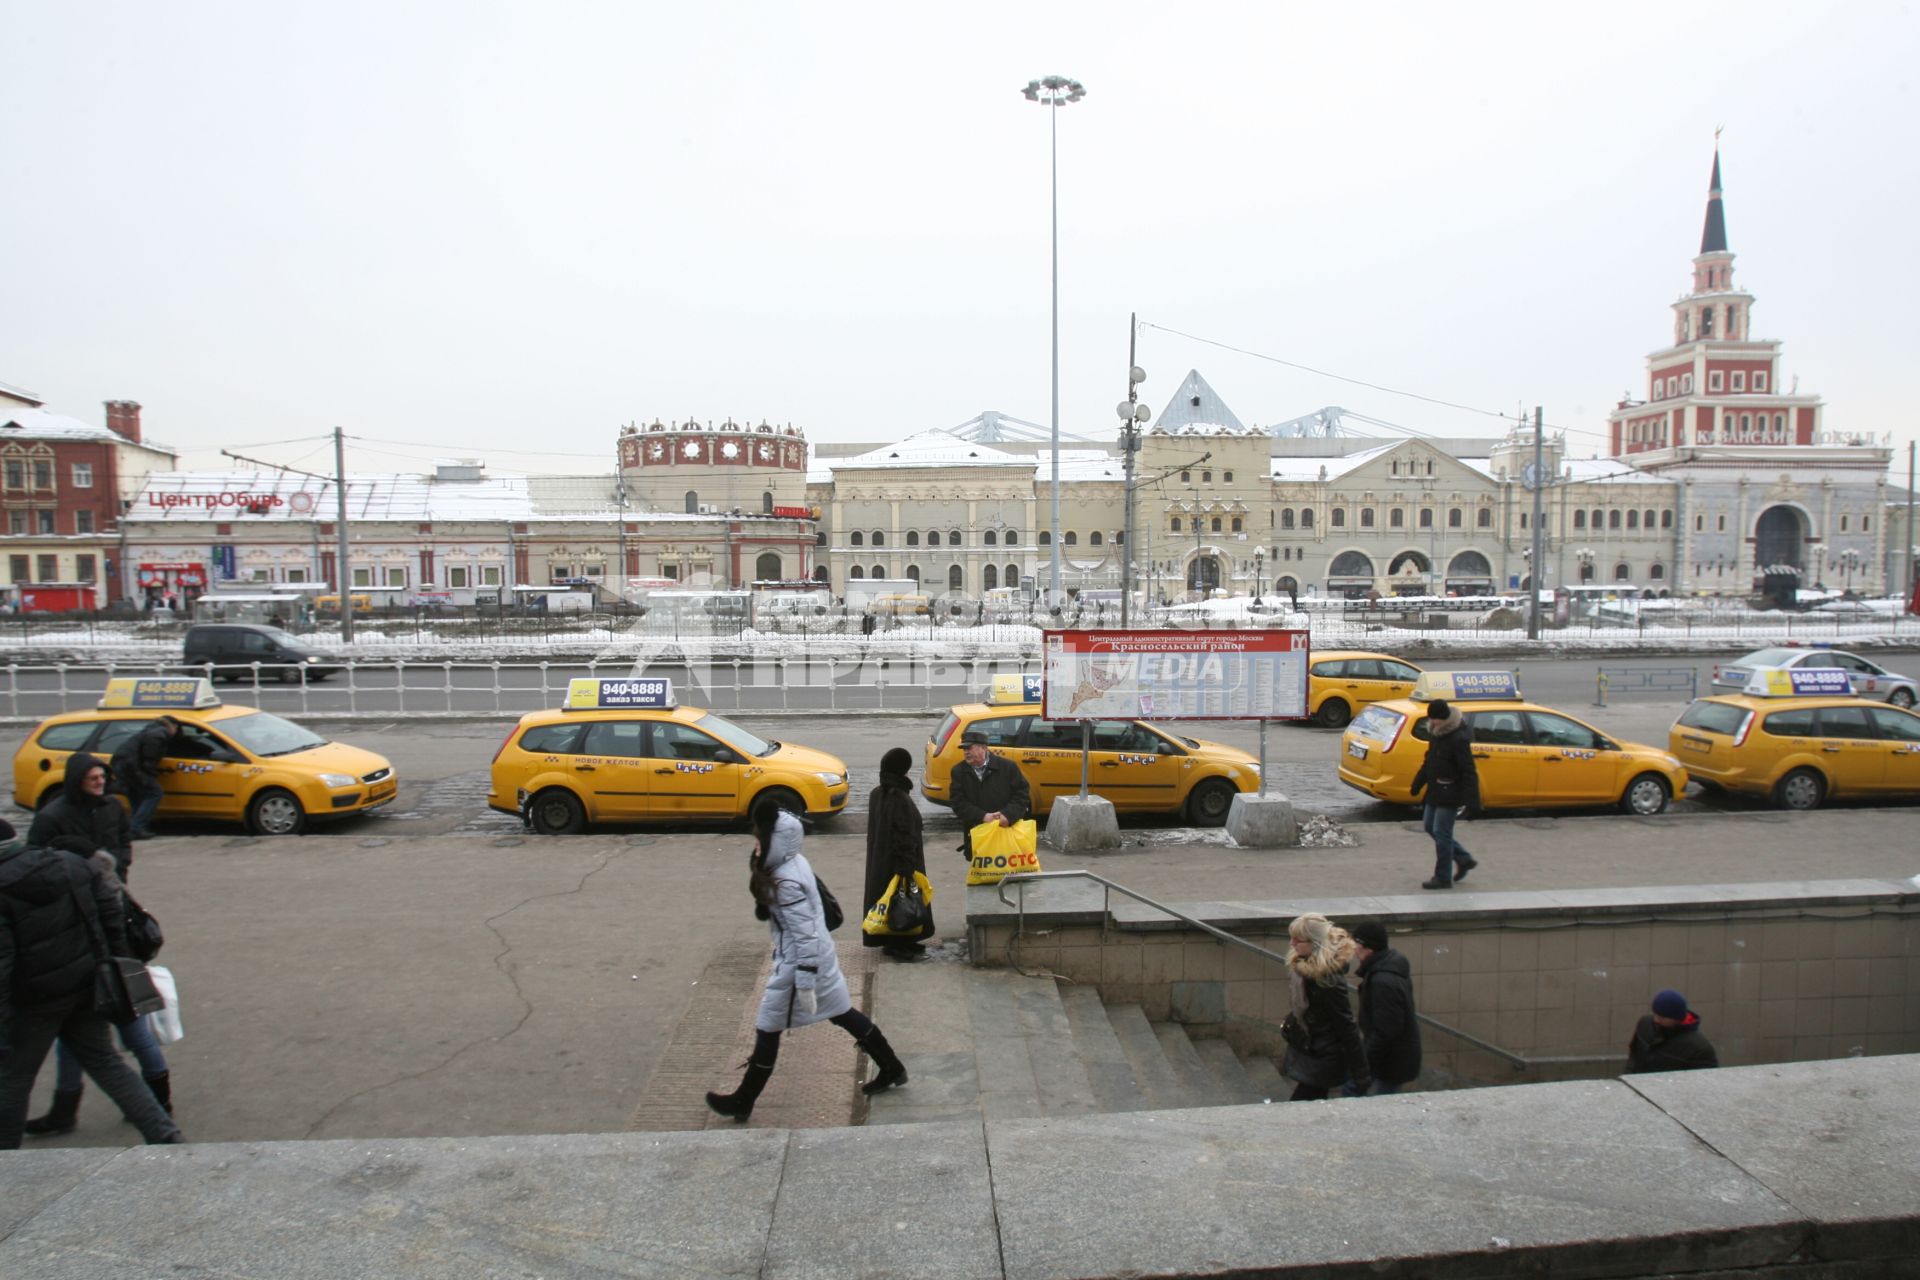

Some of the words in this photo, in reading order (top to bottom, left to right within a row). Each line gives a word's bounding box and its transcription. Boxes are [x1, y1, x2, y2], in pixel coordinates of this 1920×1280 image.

[148, 491, 284, 511] ЦентрОбувь
[1088, 635, 1133, 643] Центральный
[1134, 635, 1195, 643] административный
[1196, 636, 1215, 644] округ
[1238, 634, 1264, 642] Москвы
[1111, 641, 1207, 653] Красносельский
[1210, 641, 1245, 653] район
[1456, 675, 1510, 686] 940-8888
[1792, 673, 1845, 684] 940-8888
[138, 682, 196, 694] 940-8888
[602, 683, 663, 695] 940-8888
[605, 758, 640, 766] ЖЕЛТОЕ
[1119, 754, 1155, 765] ТАКСИ
[676, 762, 714, 774] ТАКСИ
